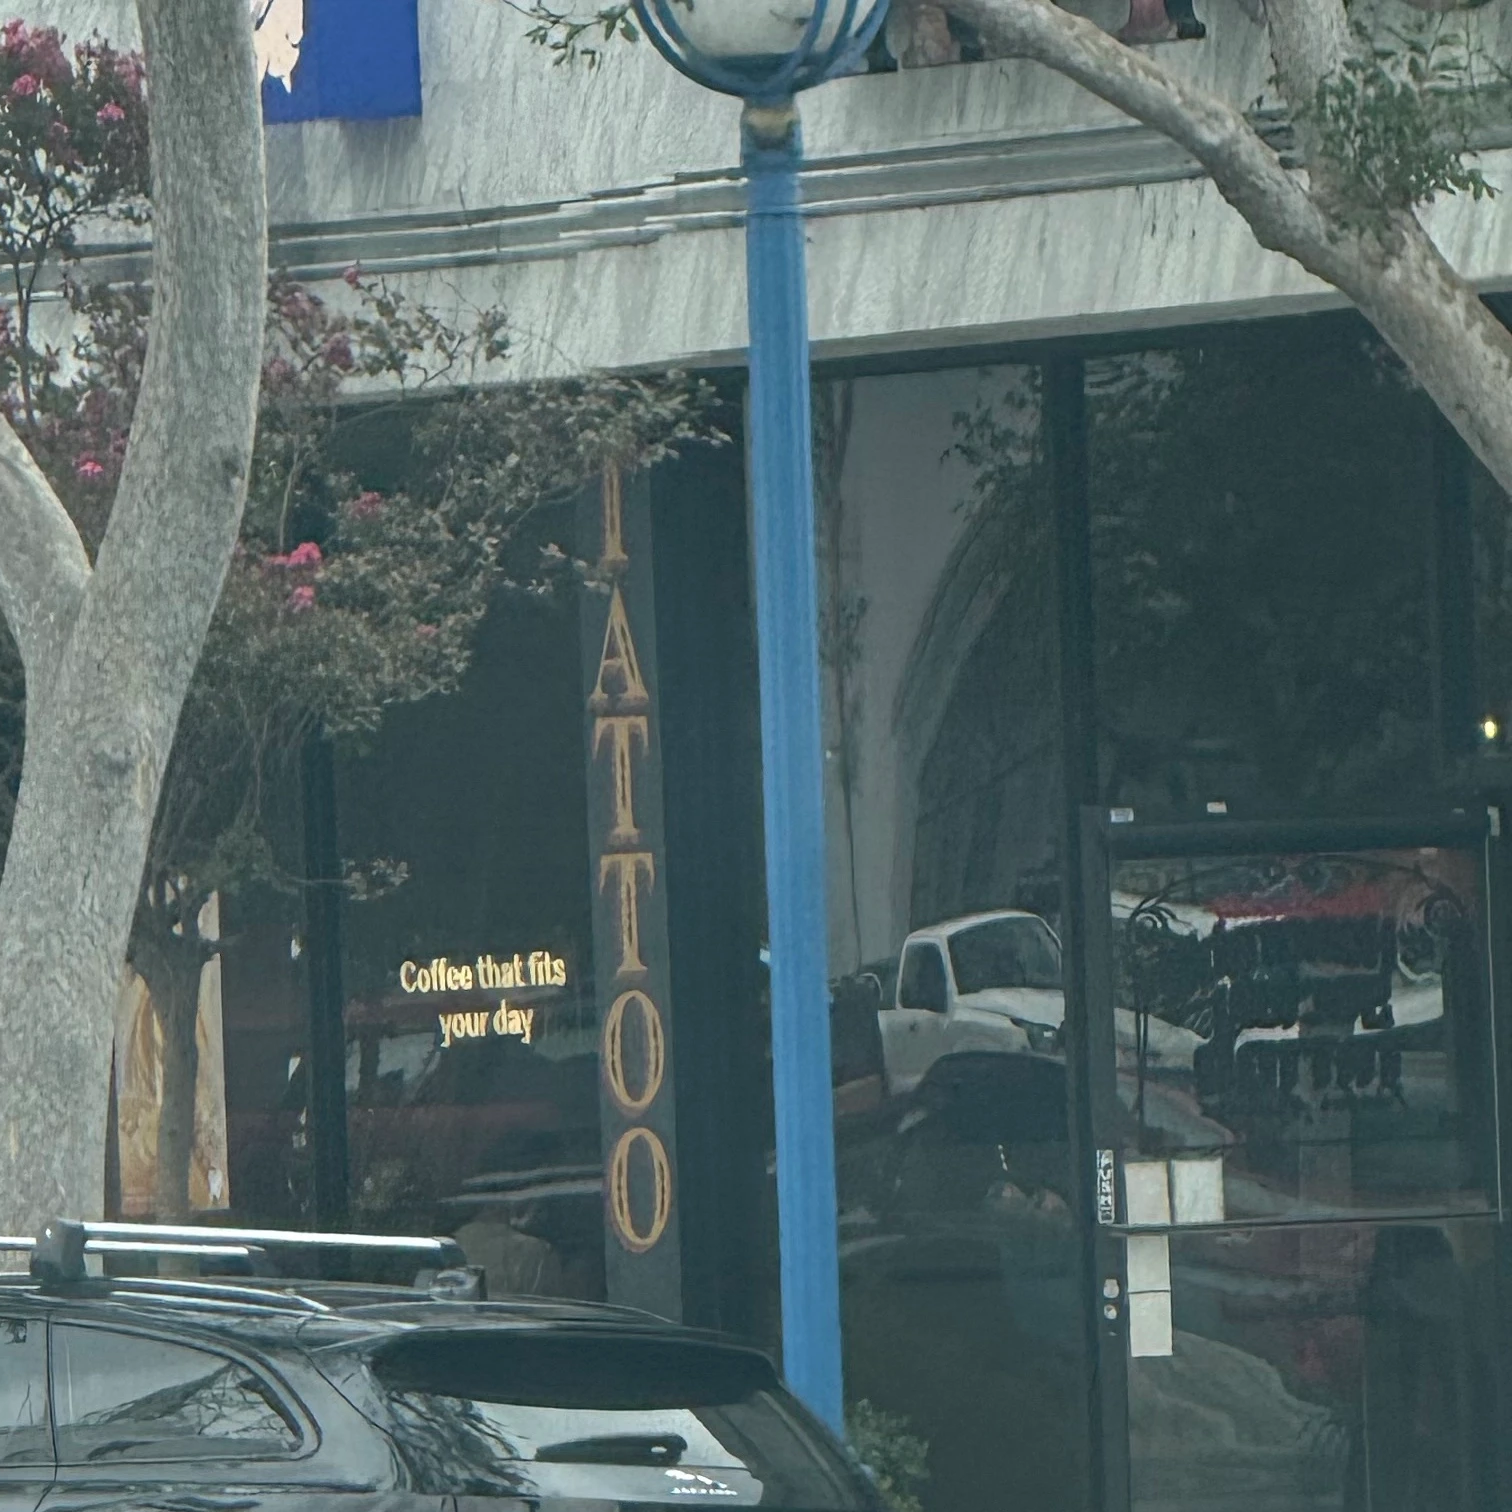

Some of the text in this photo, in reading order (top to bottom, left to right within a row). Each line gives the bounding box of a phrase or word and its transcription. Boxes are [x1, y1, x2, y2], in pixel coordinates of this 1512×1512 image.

[399, 950, 567, 994] Coffee that fits
[438, 998, 534, 1049] your day
